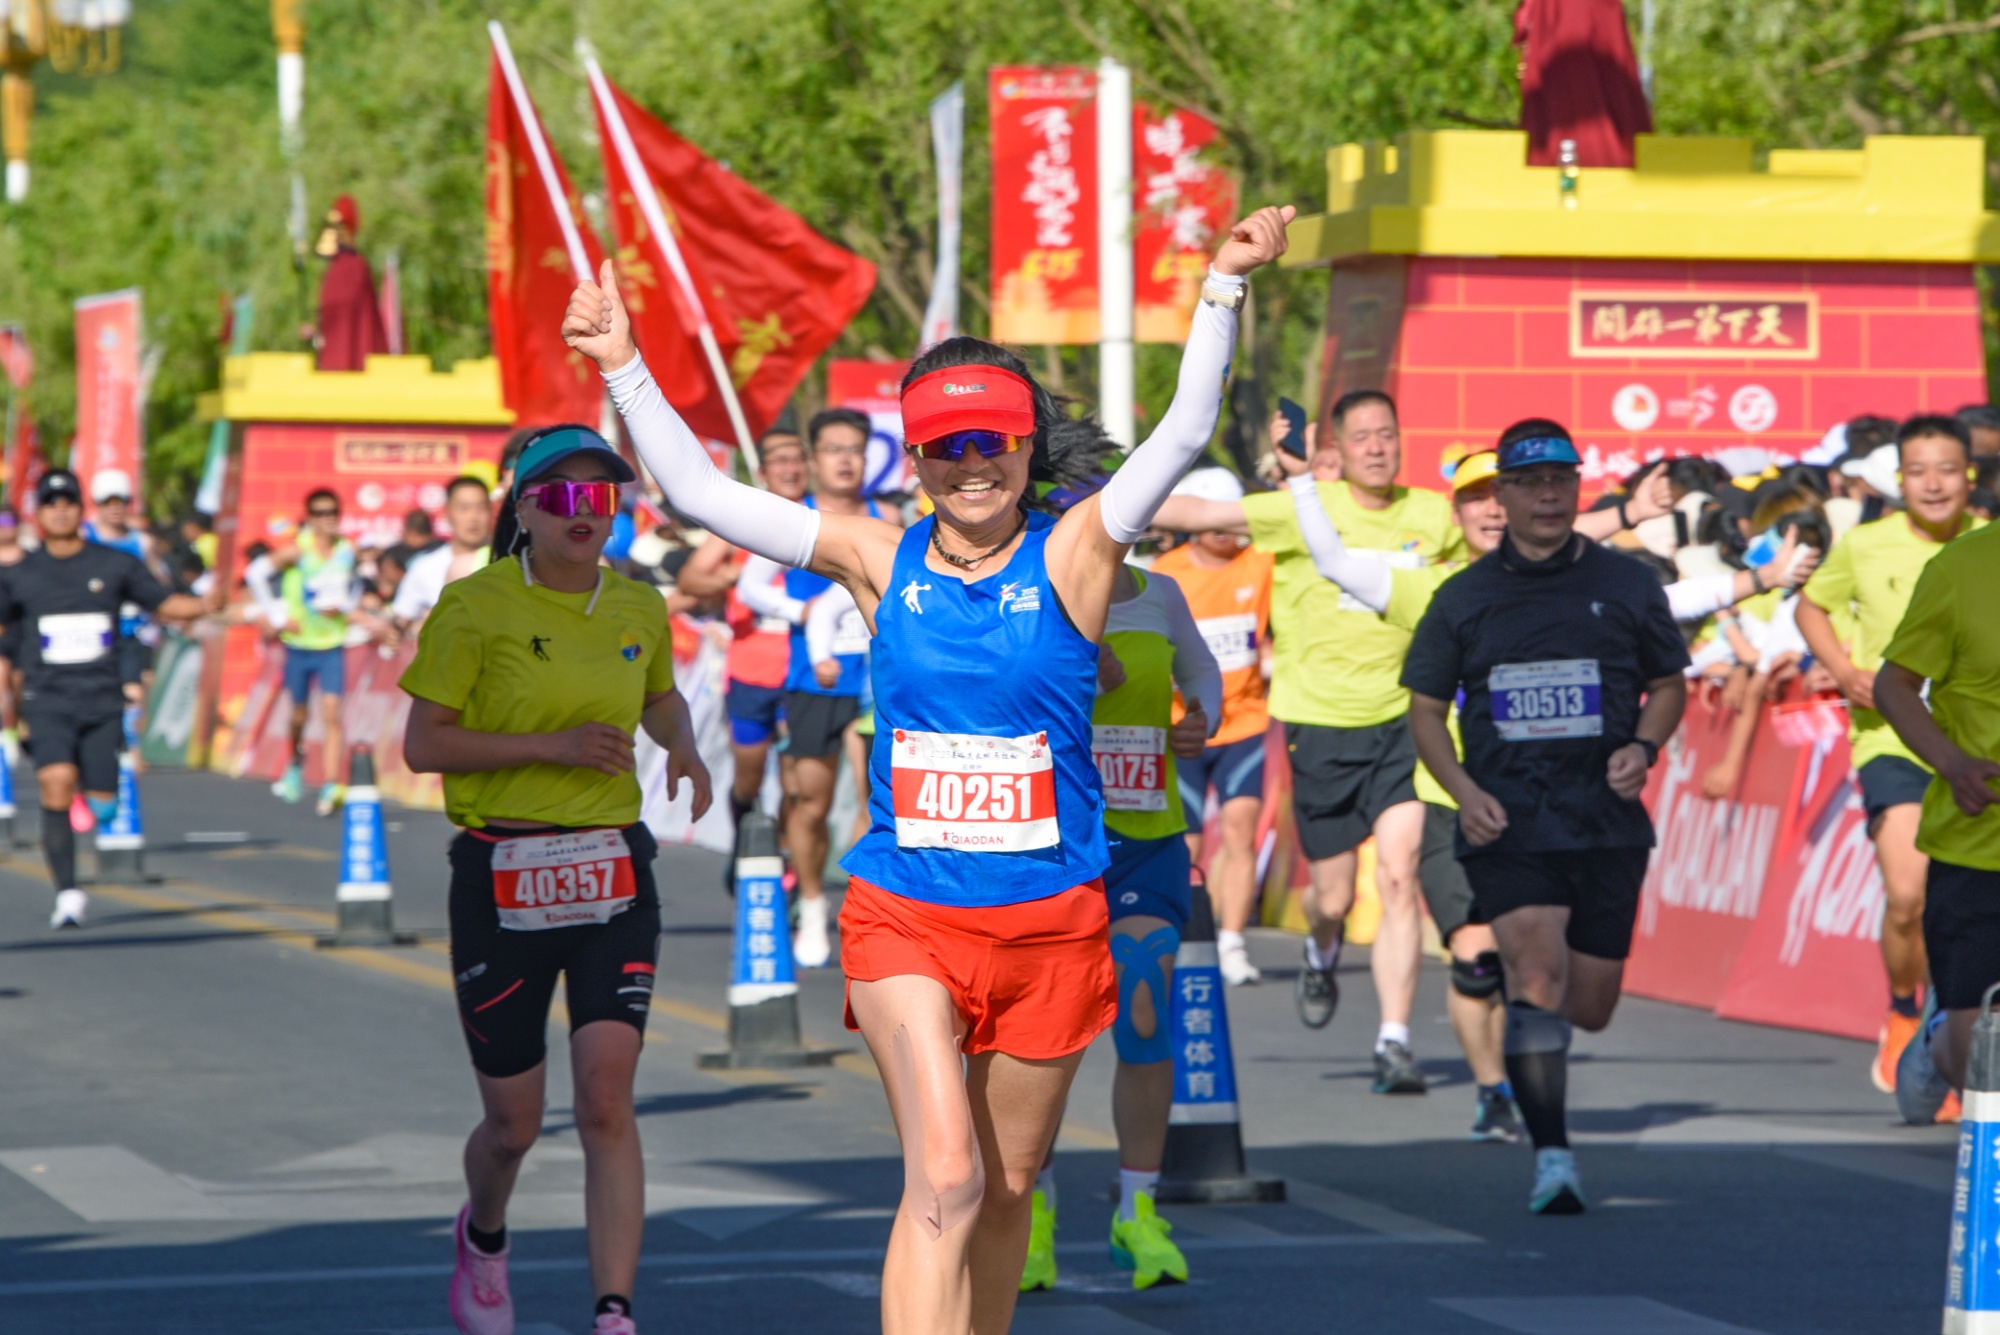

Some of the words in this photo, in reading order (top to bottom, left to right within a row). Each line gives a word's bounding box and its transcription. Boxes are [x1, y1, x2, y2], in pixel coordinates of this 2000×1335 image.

[1506, 685, 1584, 719] 30513
[916, 772, 1032, 820] 40251
[951, 834, 1004, 845] QIAODAN
[515, 860, 615, 906] 40357
[1182, 975, 1216, 1098] 行者体育
